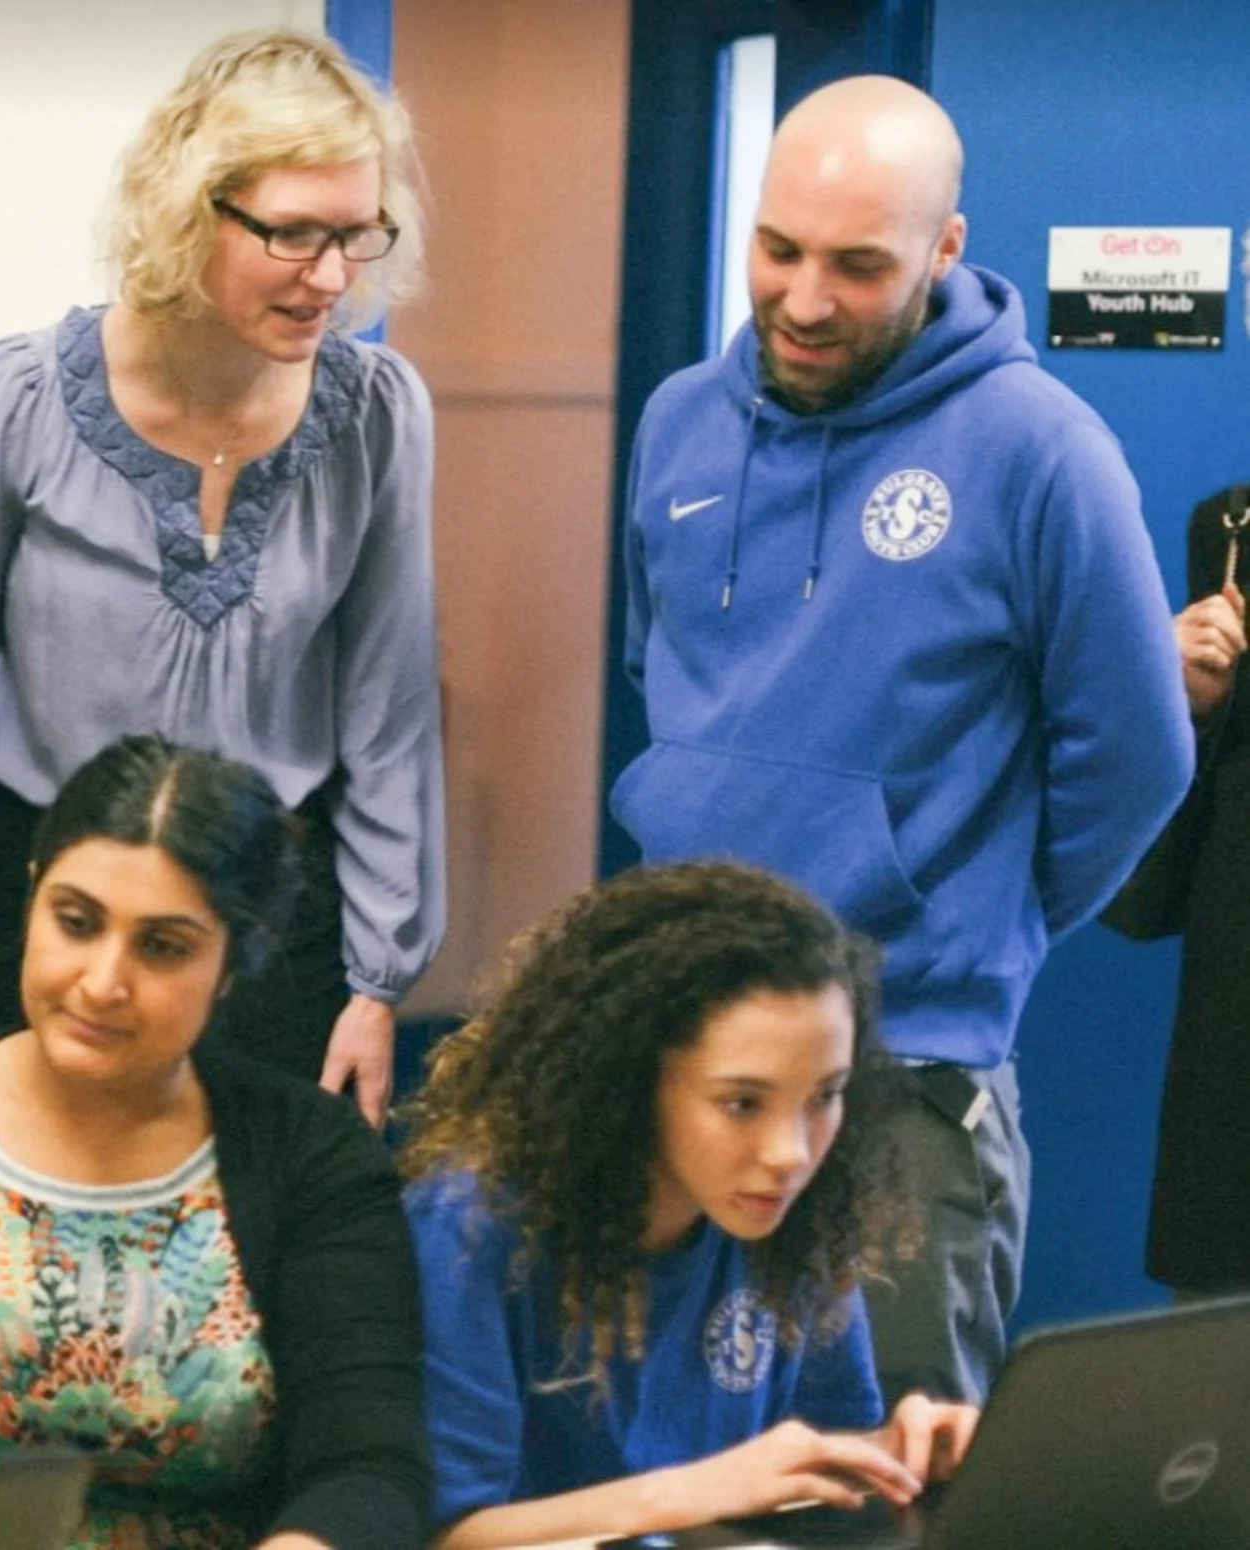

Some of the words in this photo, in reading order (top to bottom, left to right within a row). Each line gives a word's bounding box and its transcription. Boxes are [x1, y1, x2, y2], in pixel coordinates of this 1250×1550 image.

[1101, 234, 1138, 255] Get
[1145, 234, 1182, 255] On
[1082, 270, 1177, 286] Microsoft
[1183, 270, 1201, 286] IT
[1086, 293, 1146, 313] Youth
[1151, 293, 1195, 313] Hub
